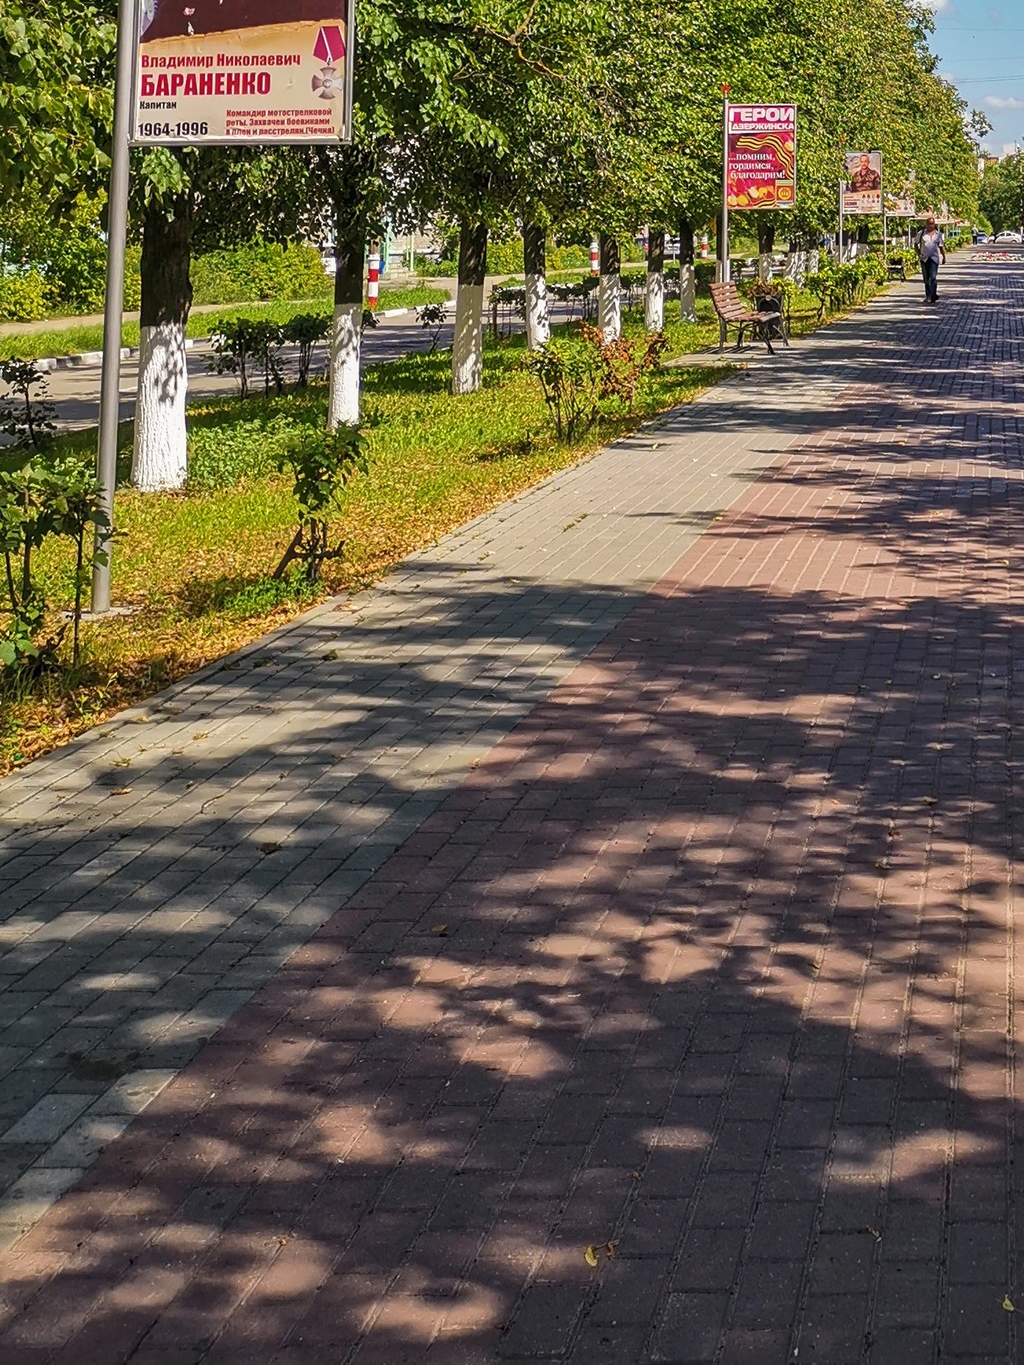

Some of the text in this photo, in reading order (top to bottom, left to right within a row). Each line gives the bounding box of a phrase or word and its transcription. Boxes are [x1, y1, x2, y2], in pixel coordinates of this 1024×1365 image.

[141, 53, 301, 69] Владимир Николаевич
[140, 71, 271, 96] БАРАНЕНКО
[139, 101, 177, 110] Капитан
[226, 108, 332, 117] Командир мотострелковой
[729, 107, 794, 122] ГЕРОИ
[249, 118, 285, 126] Захвачен
[287, 117, 330, 125] боевиками
[732, 122, 794, 130] ДЗЕРЖИНСКА
[138, 122, 208, 137] 1964-1996
[730, 170, 786, 181] благодарим!
